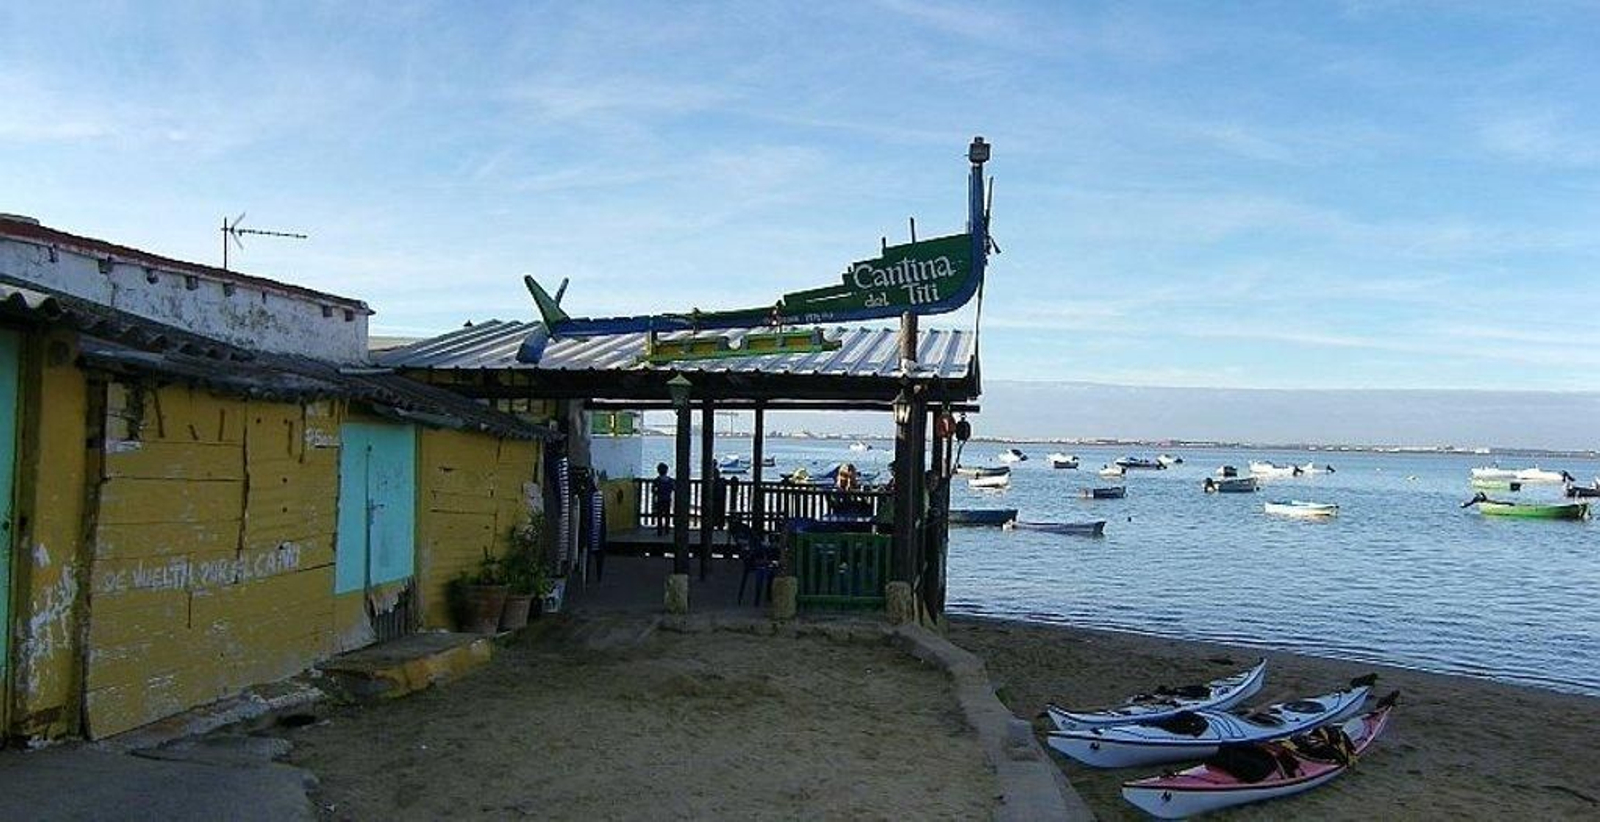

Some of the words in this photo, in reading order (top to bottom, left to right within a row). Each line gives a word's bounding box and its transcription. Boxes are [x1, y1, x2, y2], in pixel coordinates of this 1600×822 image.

[853, 256, 956, 289] Cantina
[865, 292, 889, 307] del
[901, 282, 939, 305] Titi
